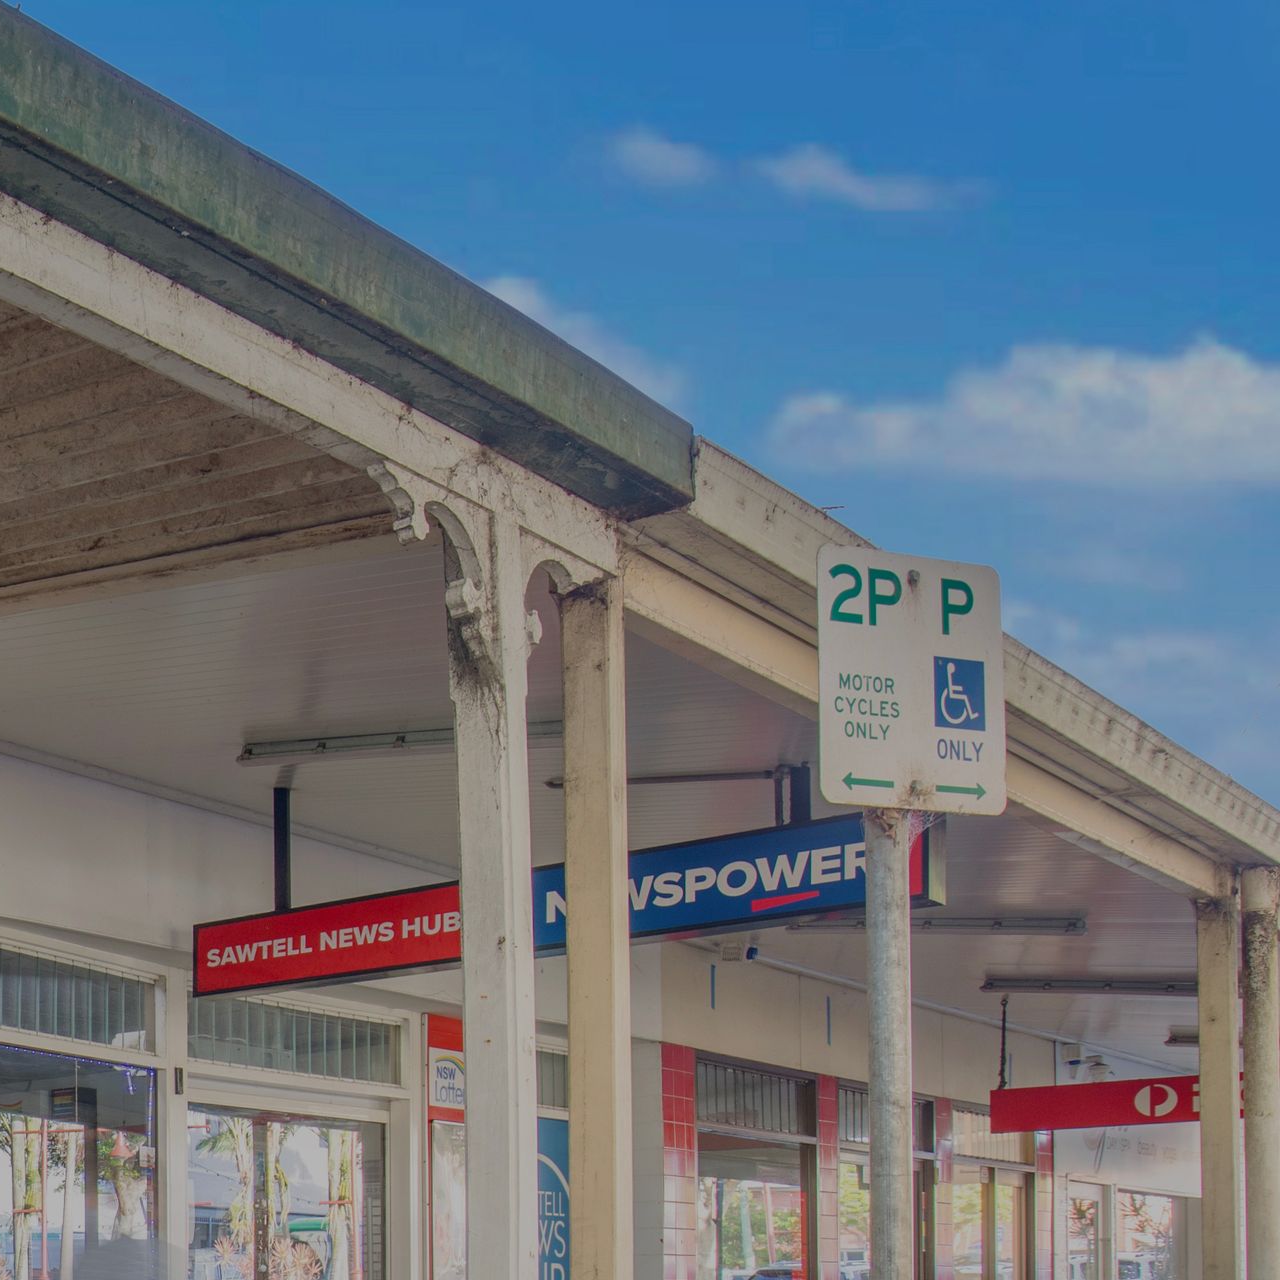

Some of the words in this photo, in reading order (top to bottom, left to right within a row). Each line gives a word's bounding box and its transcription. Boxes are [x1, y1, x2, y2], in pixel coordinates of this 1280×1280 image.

[829, 563, 902, 626] 2P
[941, 577, 974, 636] P
[839, 672, 895, 695] MOTOR
[834, 695, 900, 718] CYCLES
[844, 720, 890, 740] ONLY
[937, 738, 983, 762] ONLY
[206, 933, 313, 968] SAWTELL
[319, 919, 395, 953] NEWS
[401, 910, 462, 940] HUB
[436, 1065, 456, 1080] NSW
